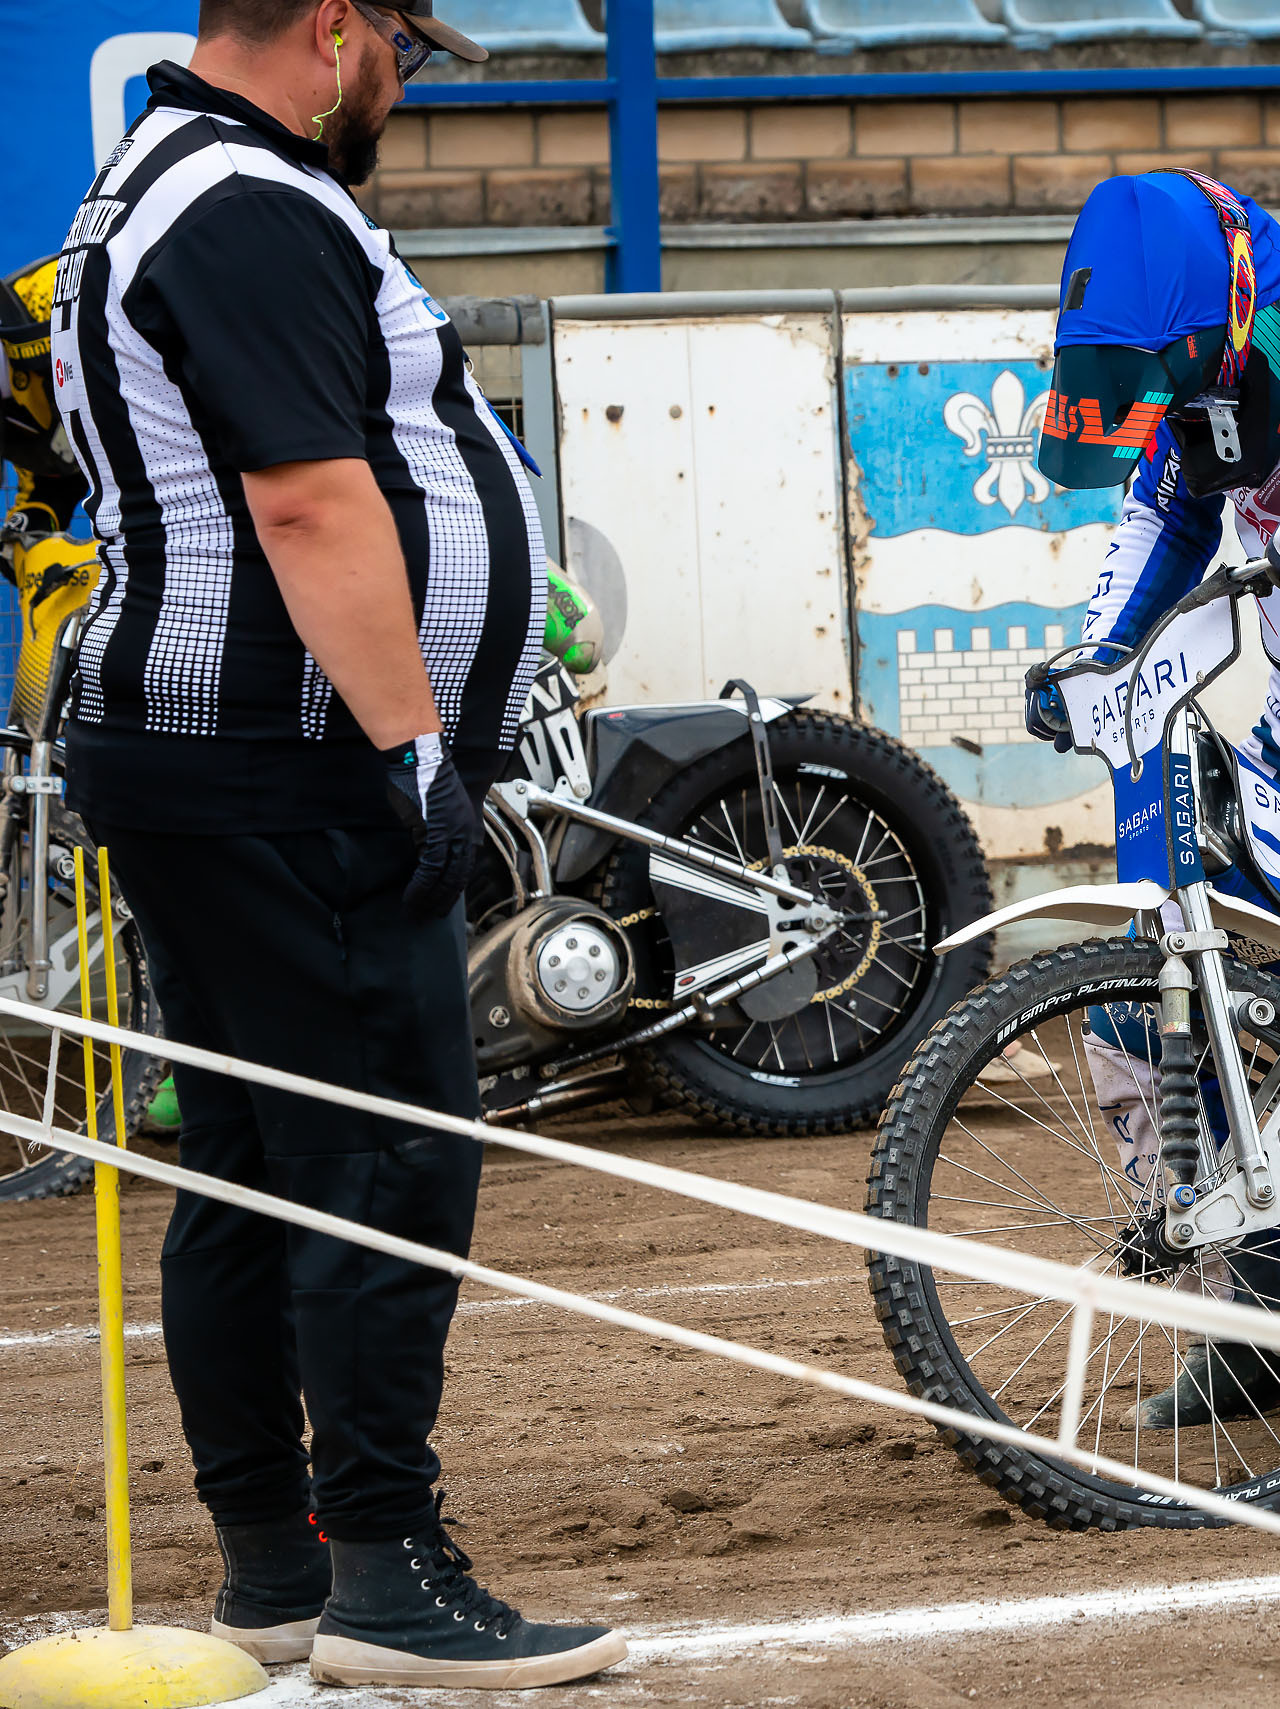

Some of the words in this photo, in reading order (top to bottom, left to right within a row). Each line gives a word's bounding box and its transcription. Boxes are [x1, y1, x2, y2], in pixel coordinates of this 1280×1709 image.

[1112, 708, 1155, 743] SPRTS
[1118, 799, 1162, 839] SAGARI
[1129, 824, 1149, 841] SPORTS
[1175, 763, 1195, 866] SAGARI
